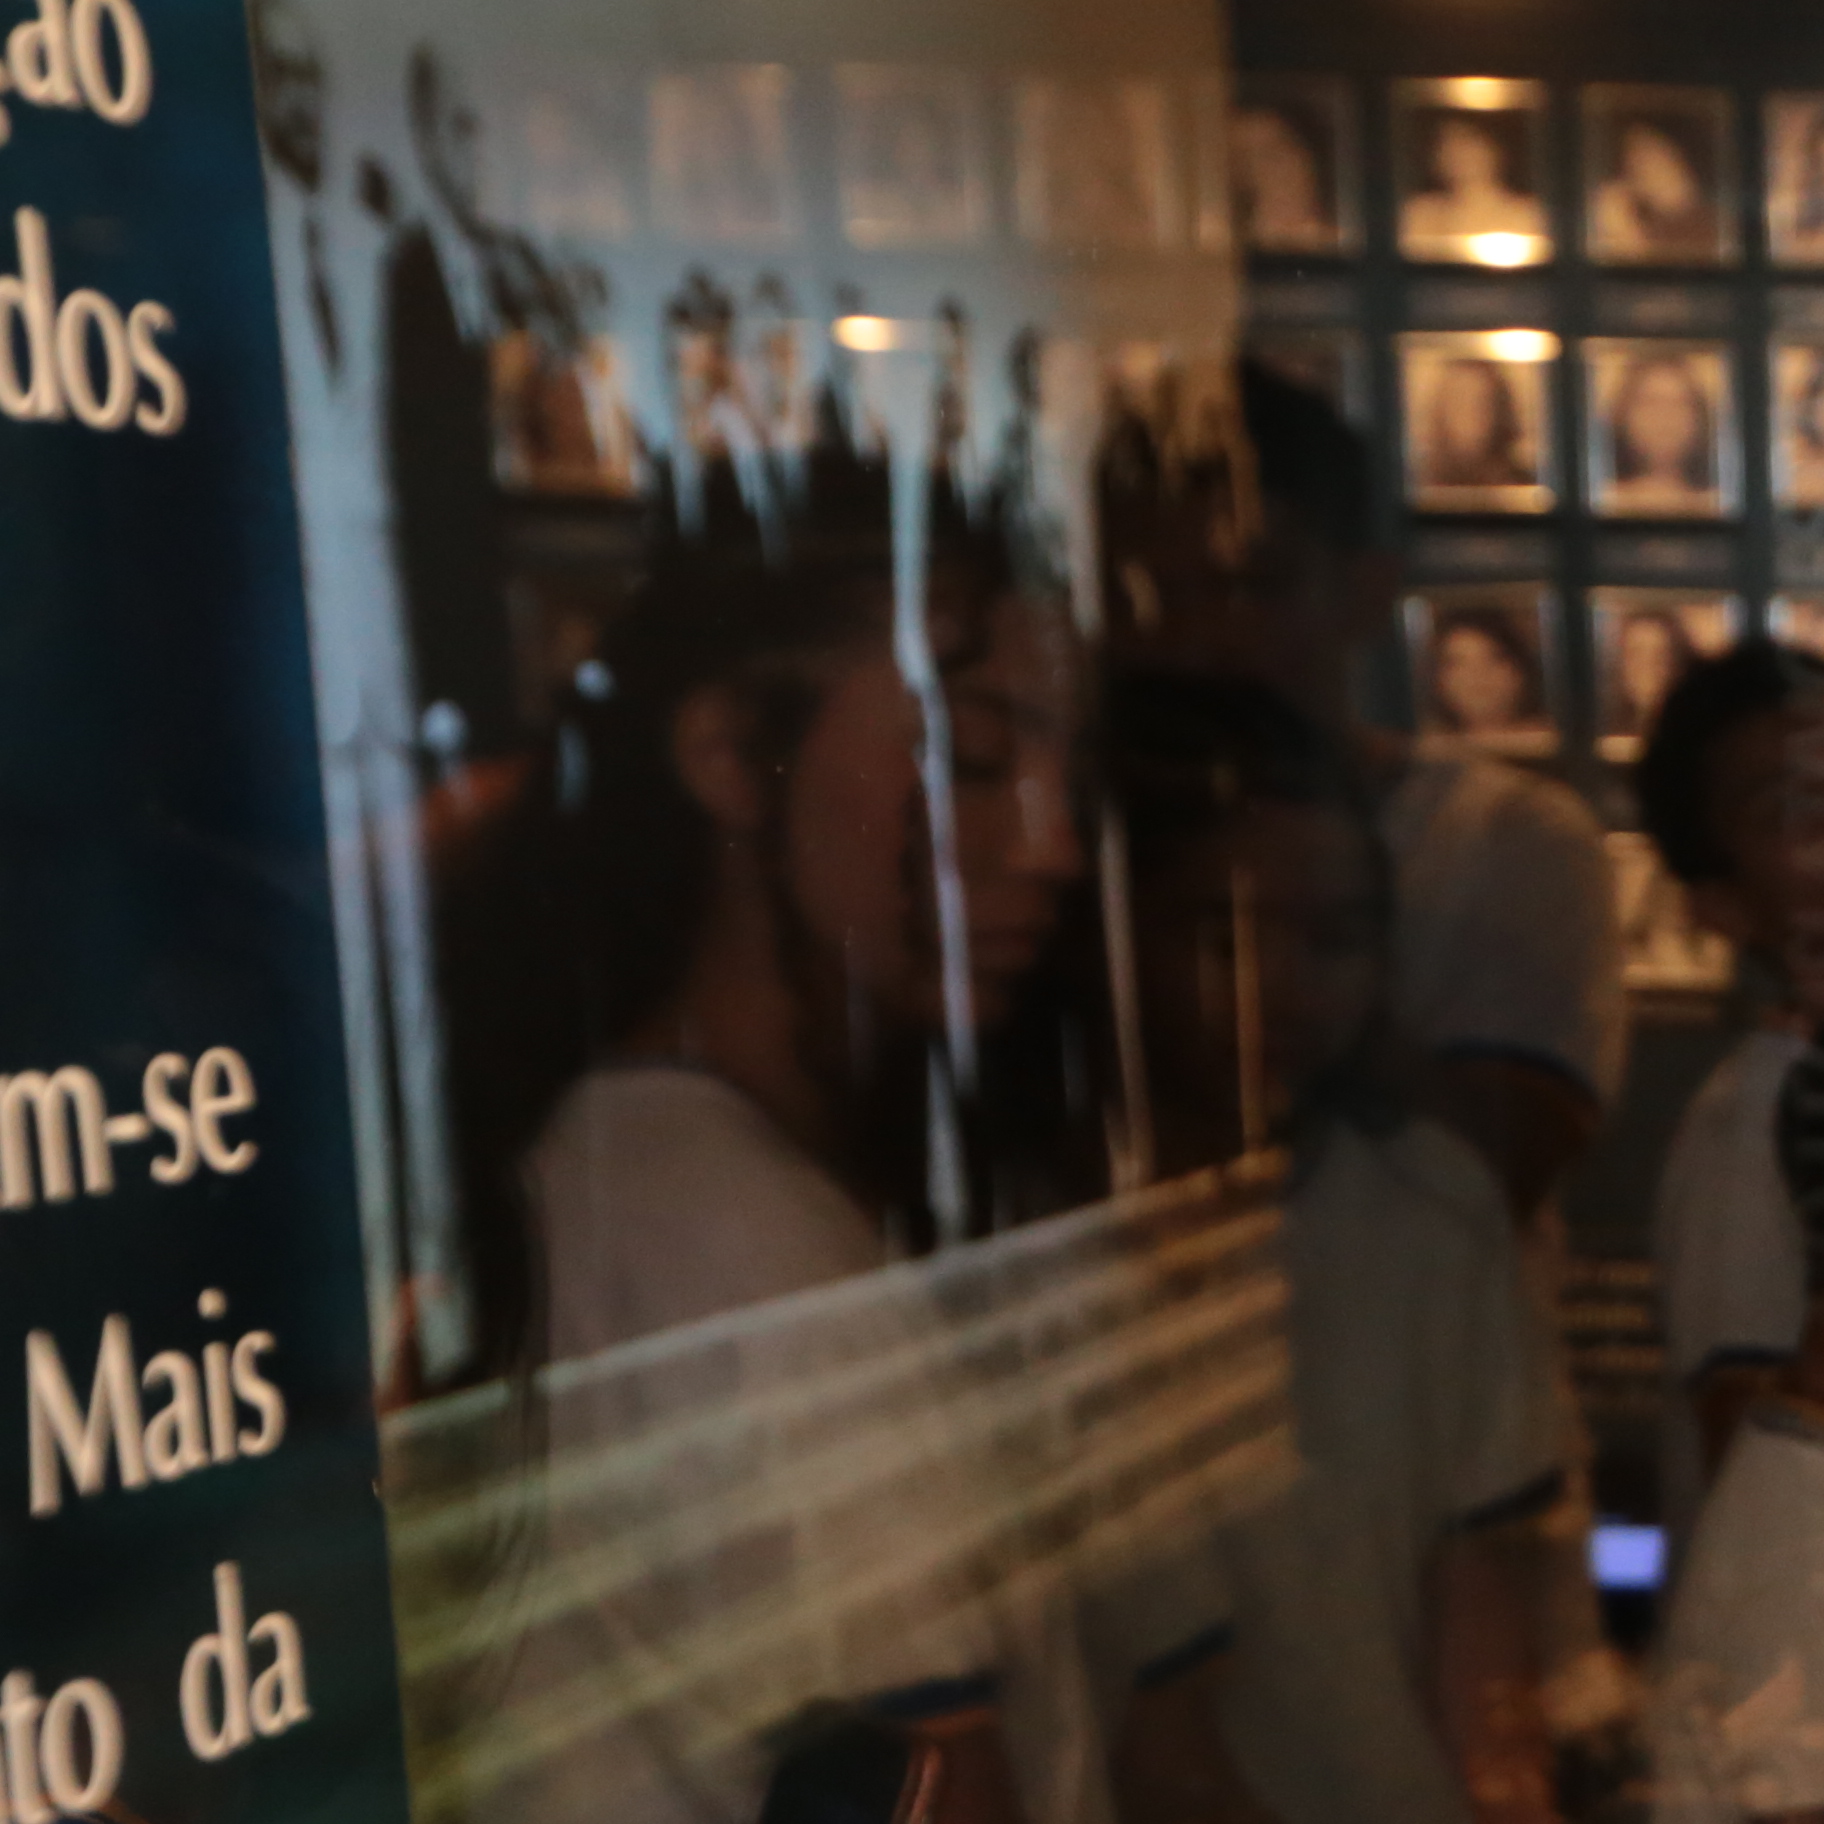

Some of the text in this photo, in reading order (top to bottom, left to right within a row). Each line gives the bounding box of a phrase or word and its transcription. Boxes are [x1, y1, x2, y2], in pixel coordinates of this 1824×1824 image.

[0, 203, 188, 437] dos
[0, 1045, 259, 1207] m-se
[25, 1287, 287, 1518] Mais
[179, 1559, 313, 1760] da
